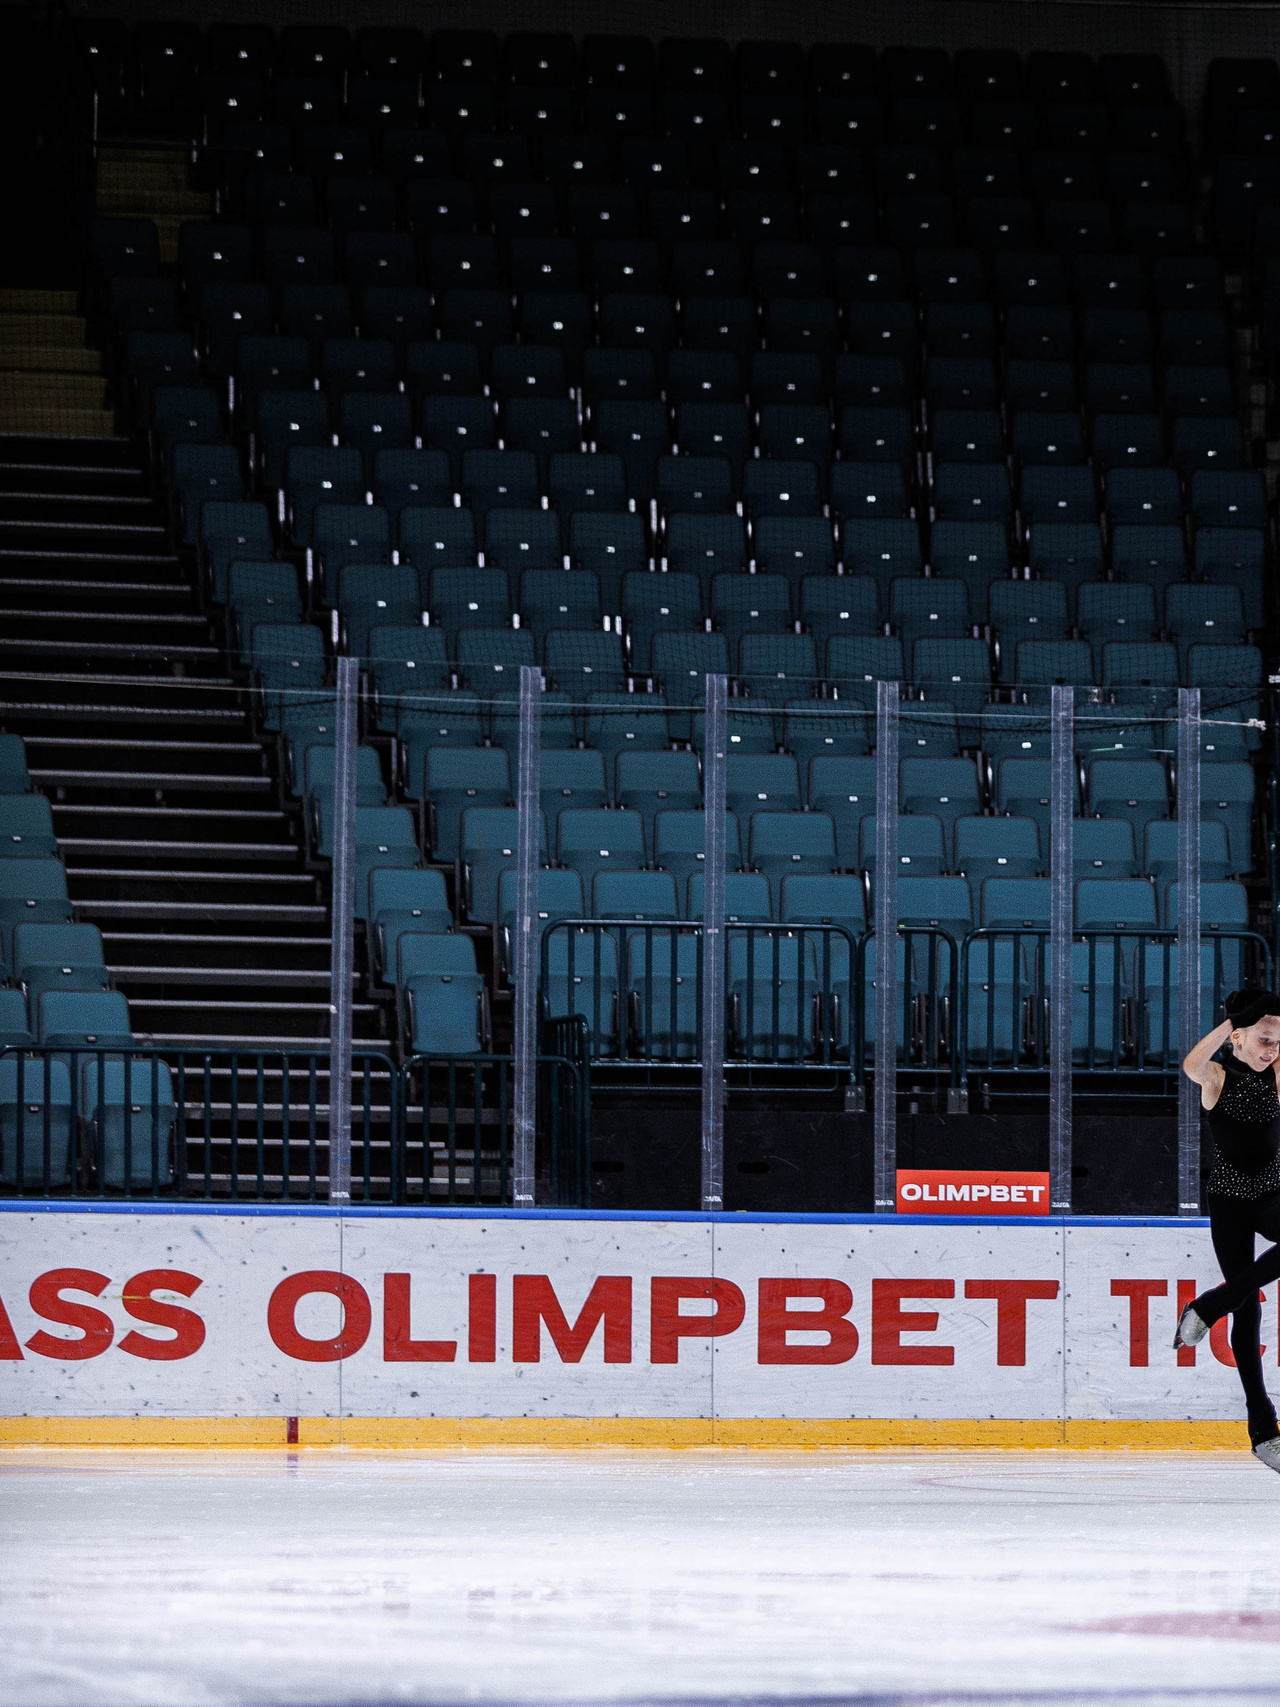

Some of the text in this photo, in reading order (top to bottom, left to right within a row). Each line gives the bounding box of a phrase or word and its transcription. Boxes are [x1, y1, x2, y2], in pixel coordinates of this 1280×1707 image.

[901, 1184, 1046, 1203] OLIMPBET
[0, 1268, 1059, 1367] SS OLIMPBET
